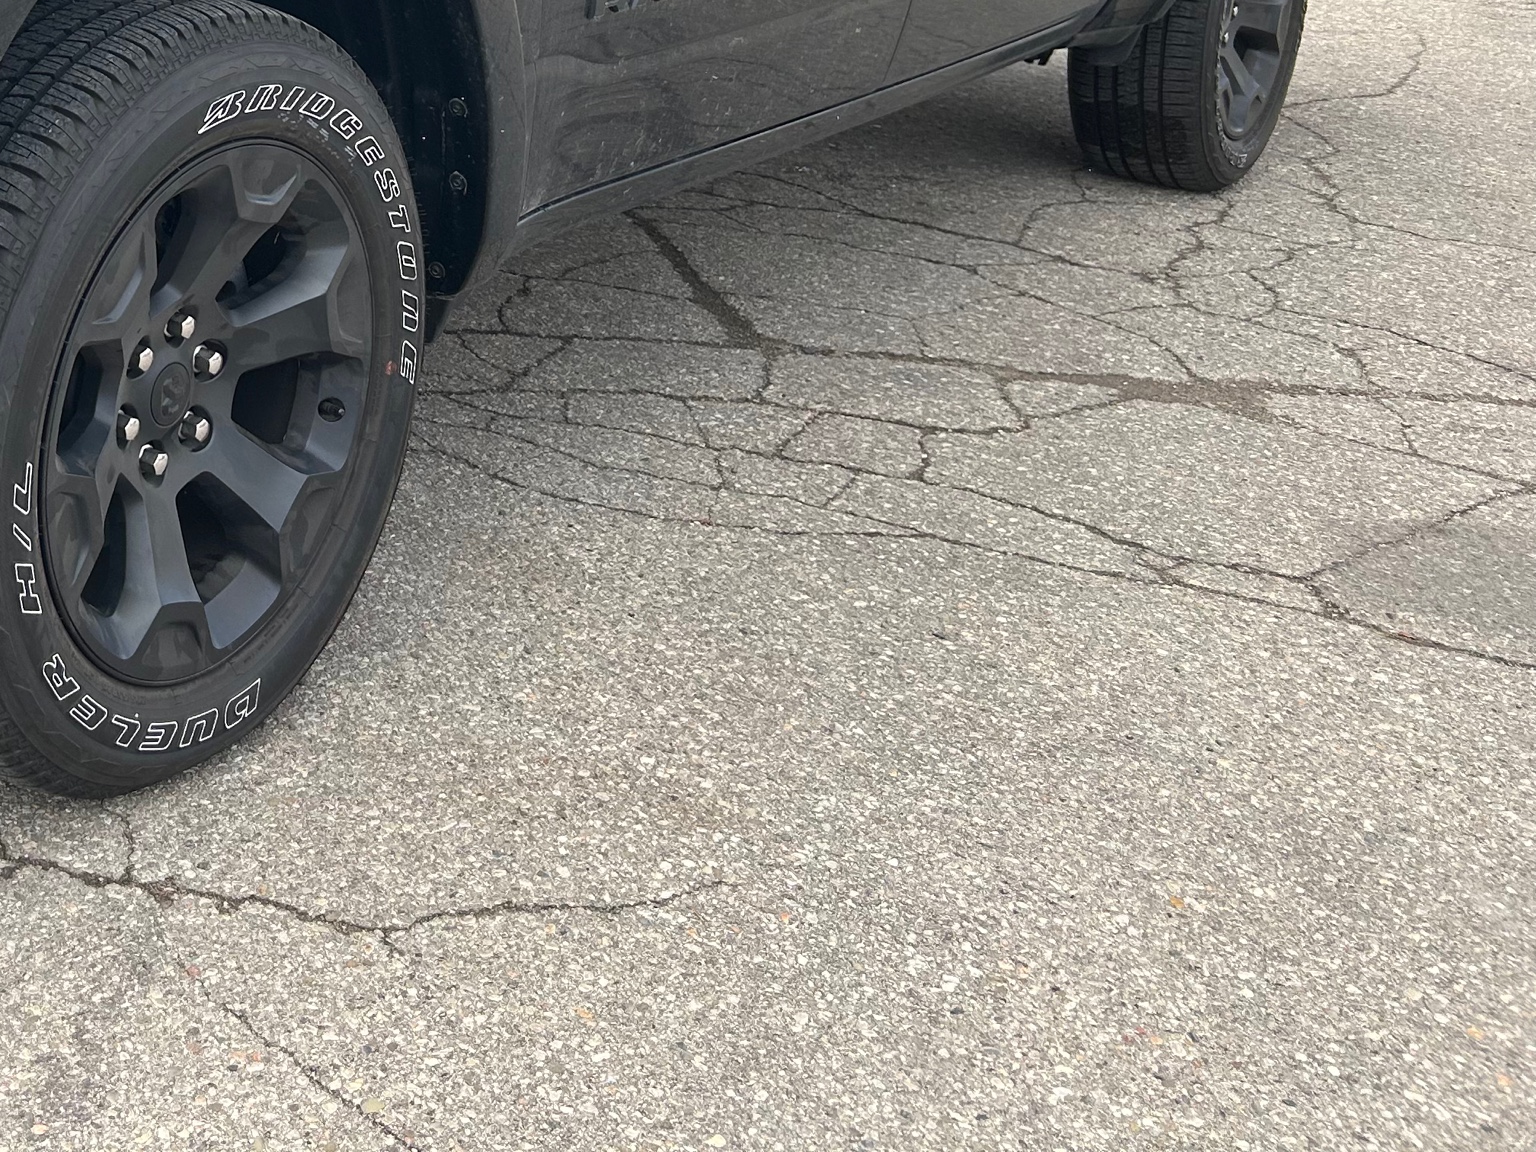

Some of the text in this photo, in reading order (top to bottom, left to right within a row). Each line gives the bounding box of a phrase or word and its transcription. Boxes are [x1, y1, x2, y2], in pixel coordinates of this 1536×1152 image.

[197, 83, 420, 385] BRIDGESTONE
[12, 461, 43, 615] H/L
[42, 652, 262, 752] DUELER
